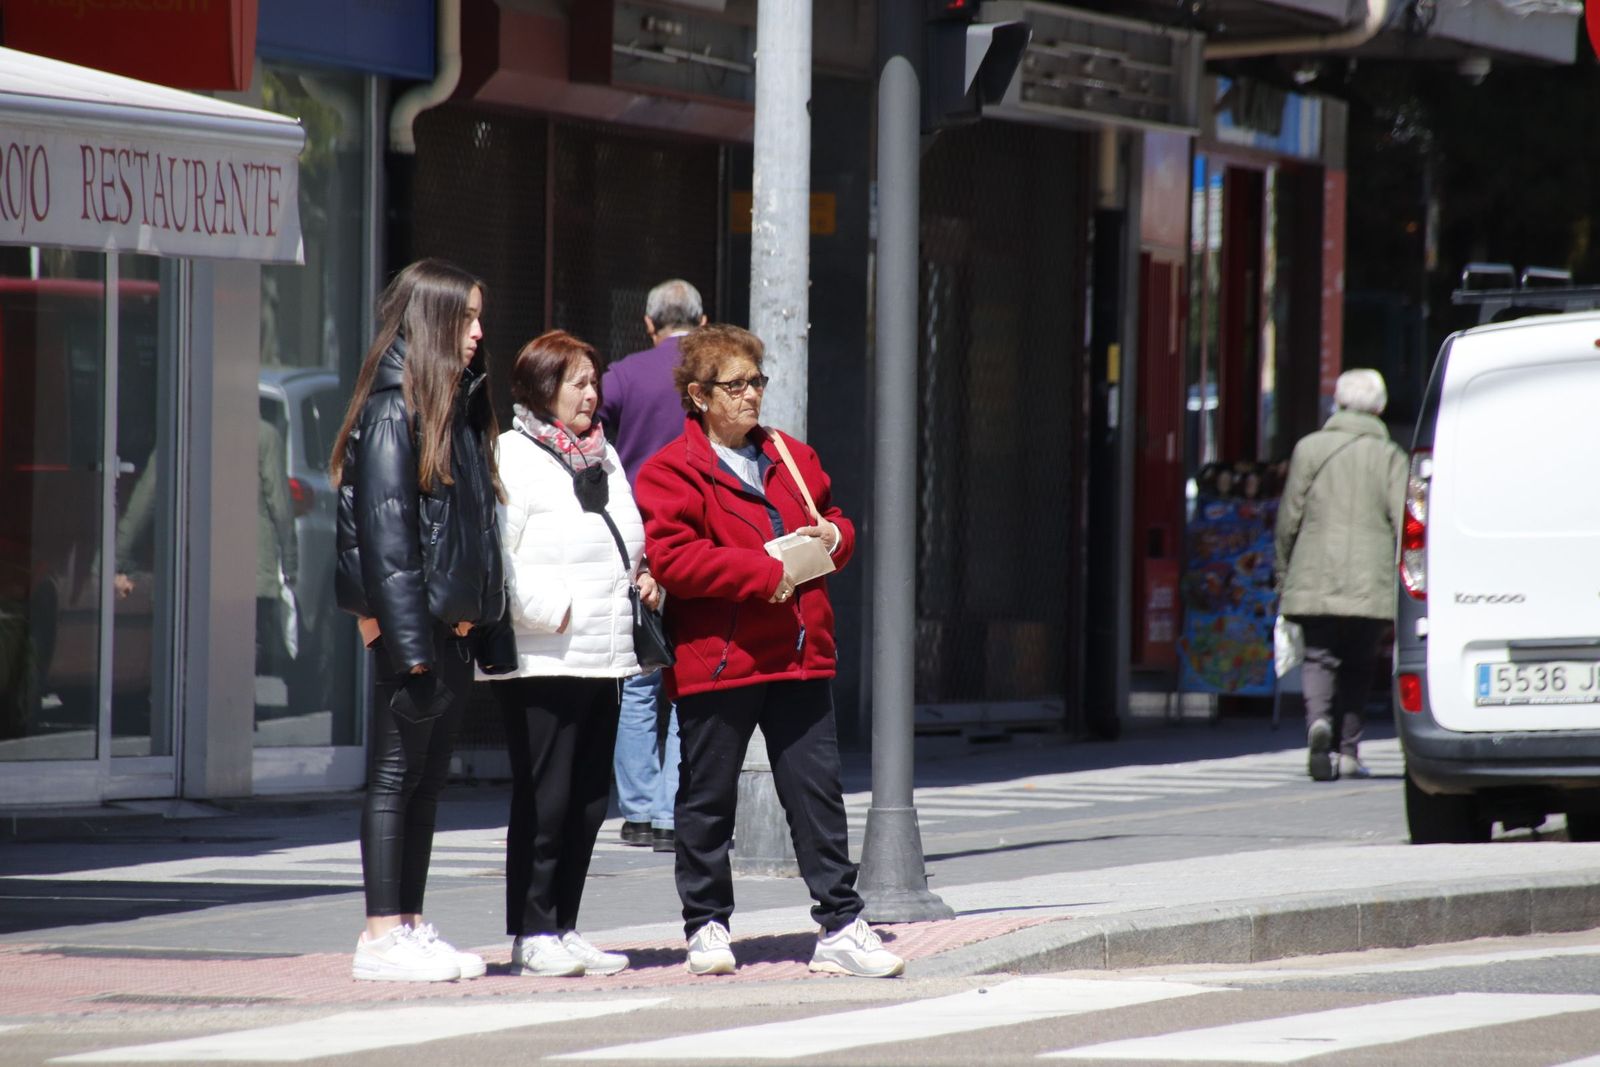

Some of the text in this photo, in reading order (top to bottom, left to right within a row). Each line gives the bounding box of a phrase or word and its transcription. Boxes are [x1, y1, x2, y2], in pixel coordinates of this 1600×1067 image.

[80, 144, 282, 236] RESTAURANTE
[1497, 667, 1567, 692] 5536
[1579, 665, 1600, 691] J
